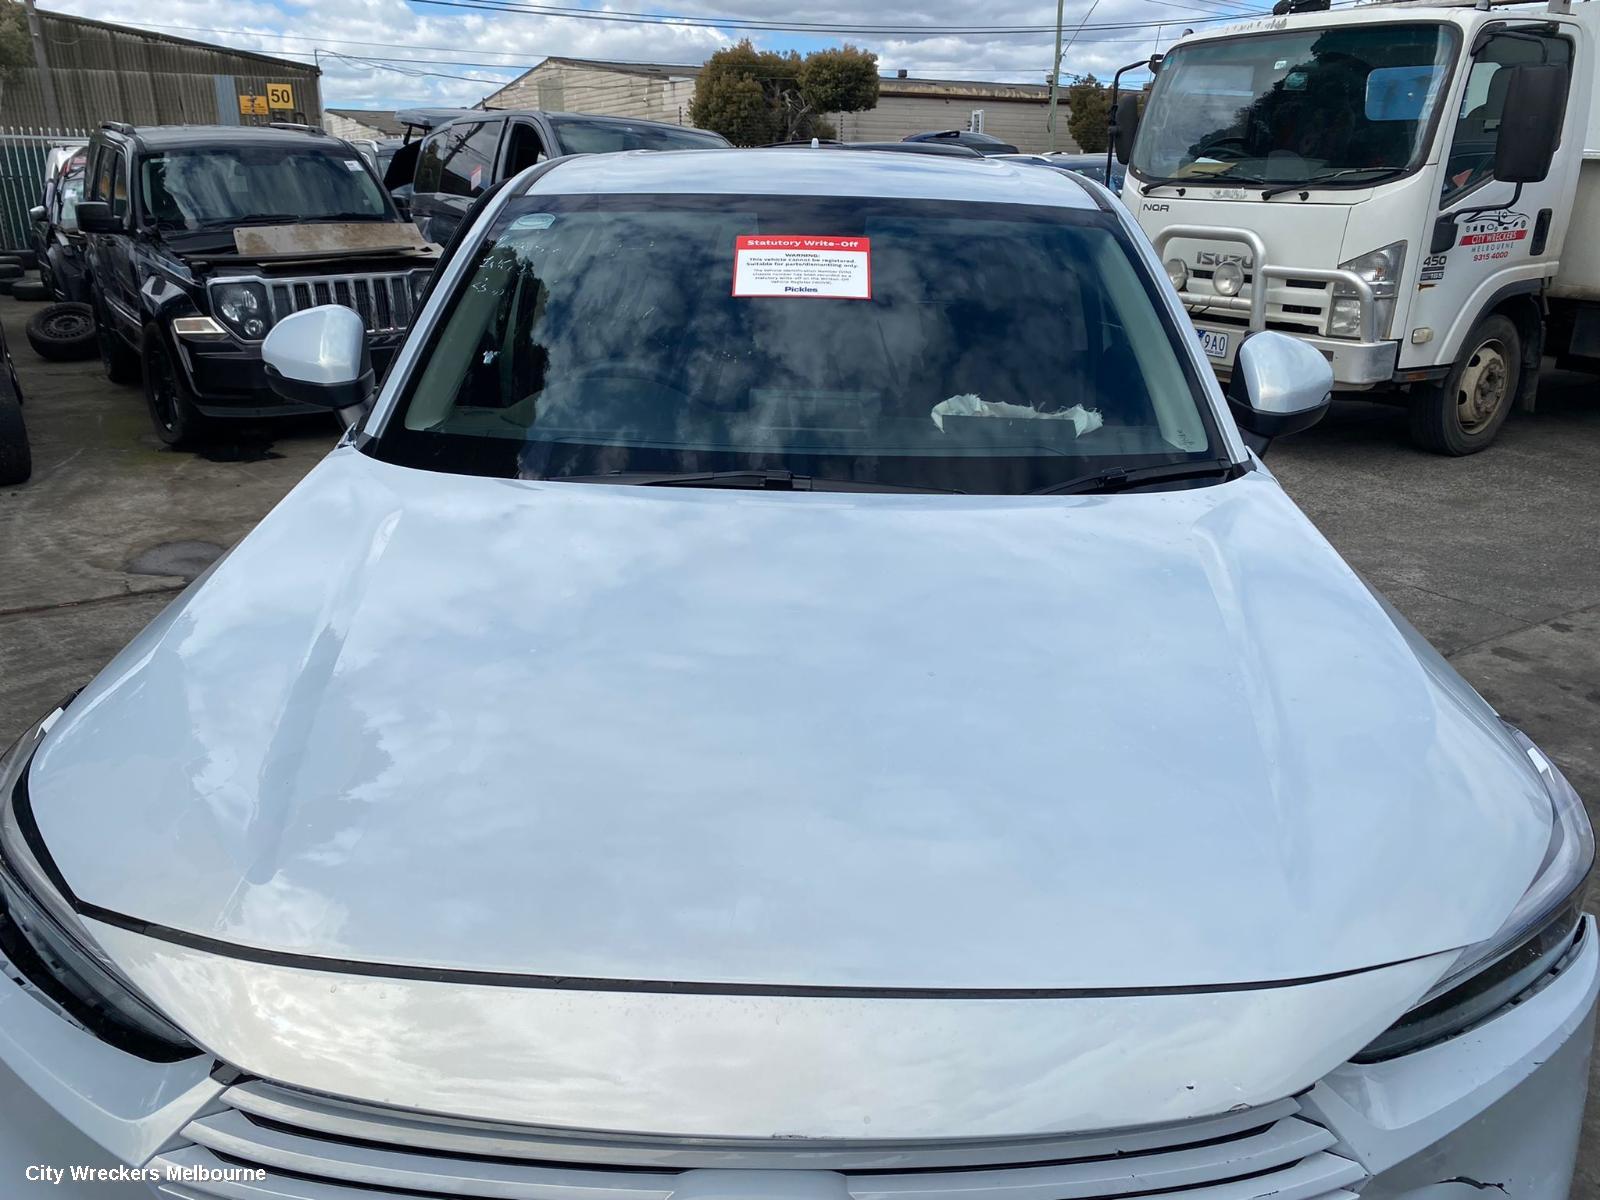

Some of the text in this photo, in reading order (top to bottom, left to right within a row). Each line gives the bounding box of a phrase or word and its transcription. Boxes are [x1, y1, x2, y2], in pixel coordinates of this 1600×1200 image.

[271, 89, 290, 103] 50
[1143, 203, 1170, 212] NQR
[747, 239, 801, 247] Statutory
[1471, 231, 1517, 244] CITY WRECKERS
[1471, 242, 1514, 253] MELBOURNE
[1196, 251, 1253, 269] ISUZU
[1423, 256, 1447, 266] 450
[1473, 251, 1508, 262] 9315 4000
